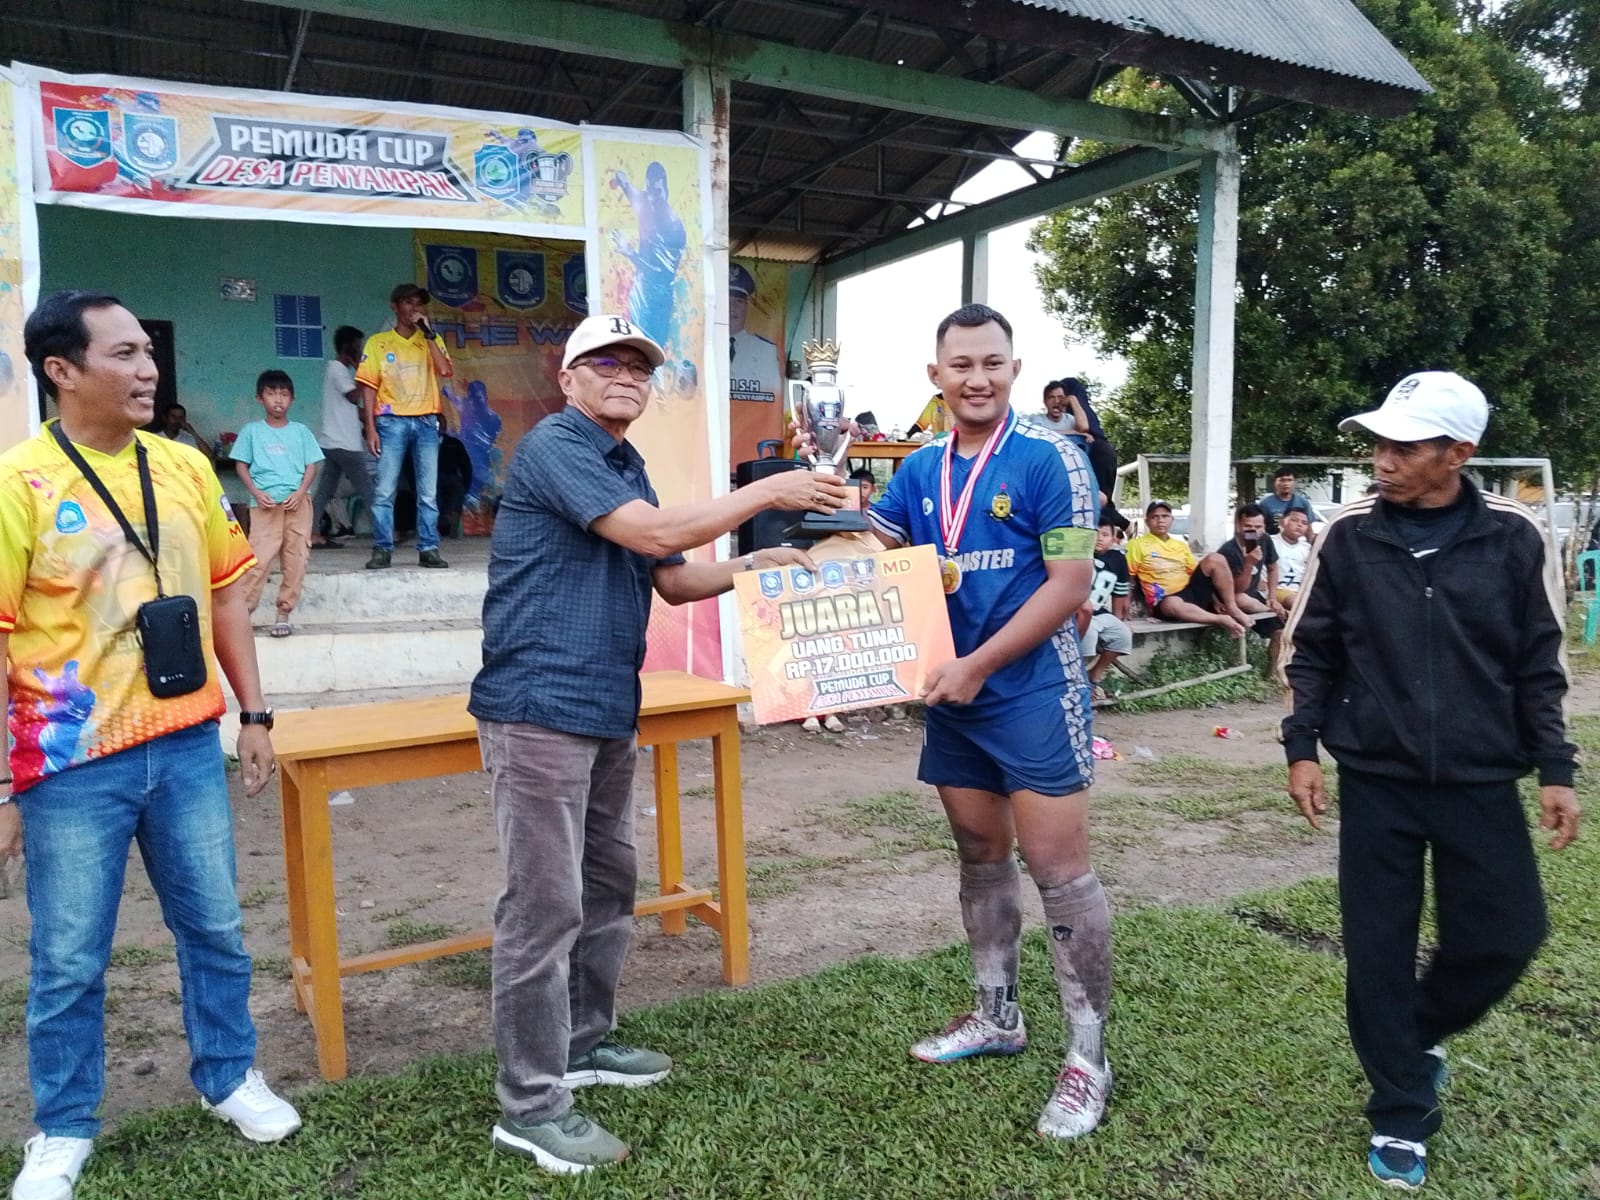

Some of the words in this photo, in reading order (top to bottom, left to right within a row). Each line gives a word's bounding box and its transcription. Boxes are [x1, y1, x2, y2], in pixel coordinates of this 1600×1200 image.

[230, 124, 368, 161] PEMUDA
[378, 136, 434, 166] CUP
[196, 155, 285, 186] DESA
[289, 161, 468, 201] PENYAMPAK
[431, 318, 519, 348] THE
[1044, 532, 1064, 555] C
[883, 560, 911, 576] MD
[780, 590, 883, 639] JUARA
[882, 586, 904, 623] 1
[792, 636, 844, 659] UANG
[847, 627, 905, 650] TUNAI
[820, 676, 867, 694] PEMUDA
[869, 673, 890, 686] CUP
